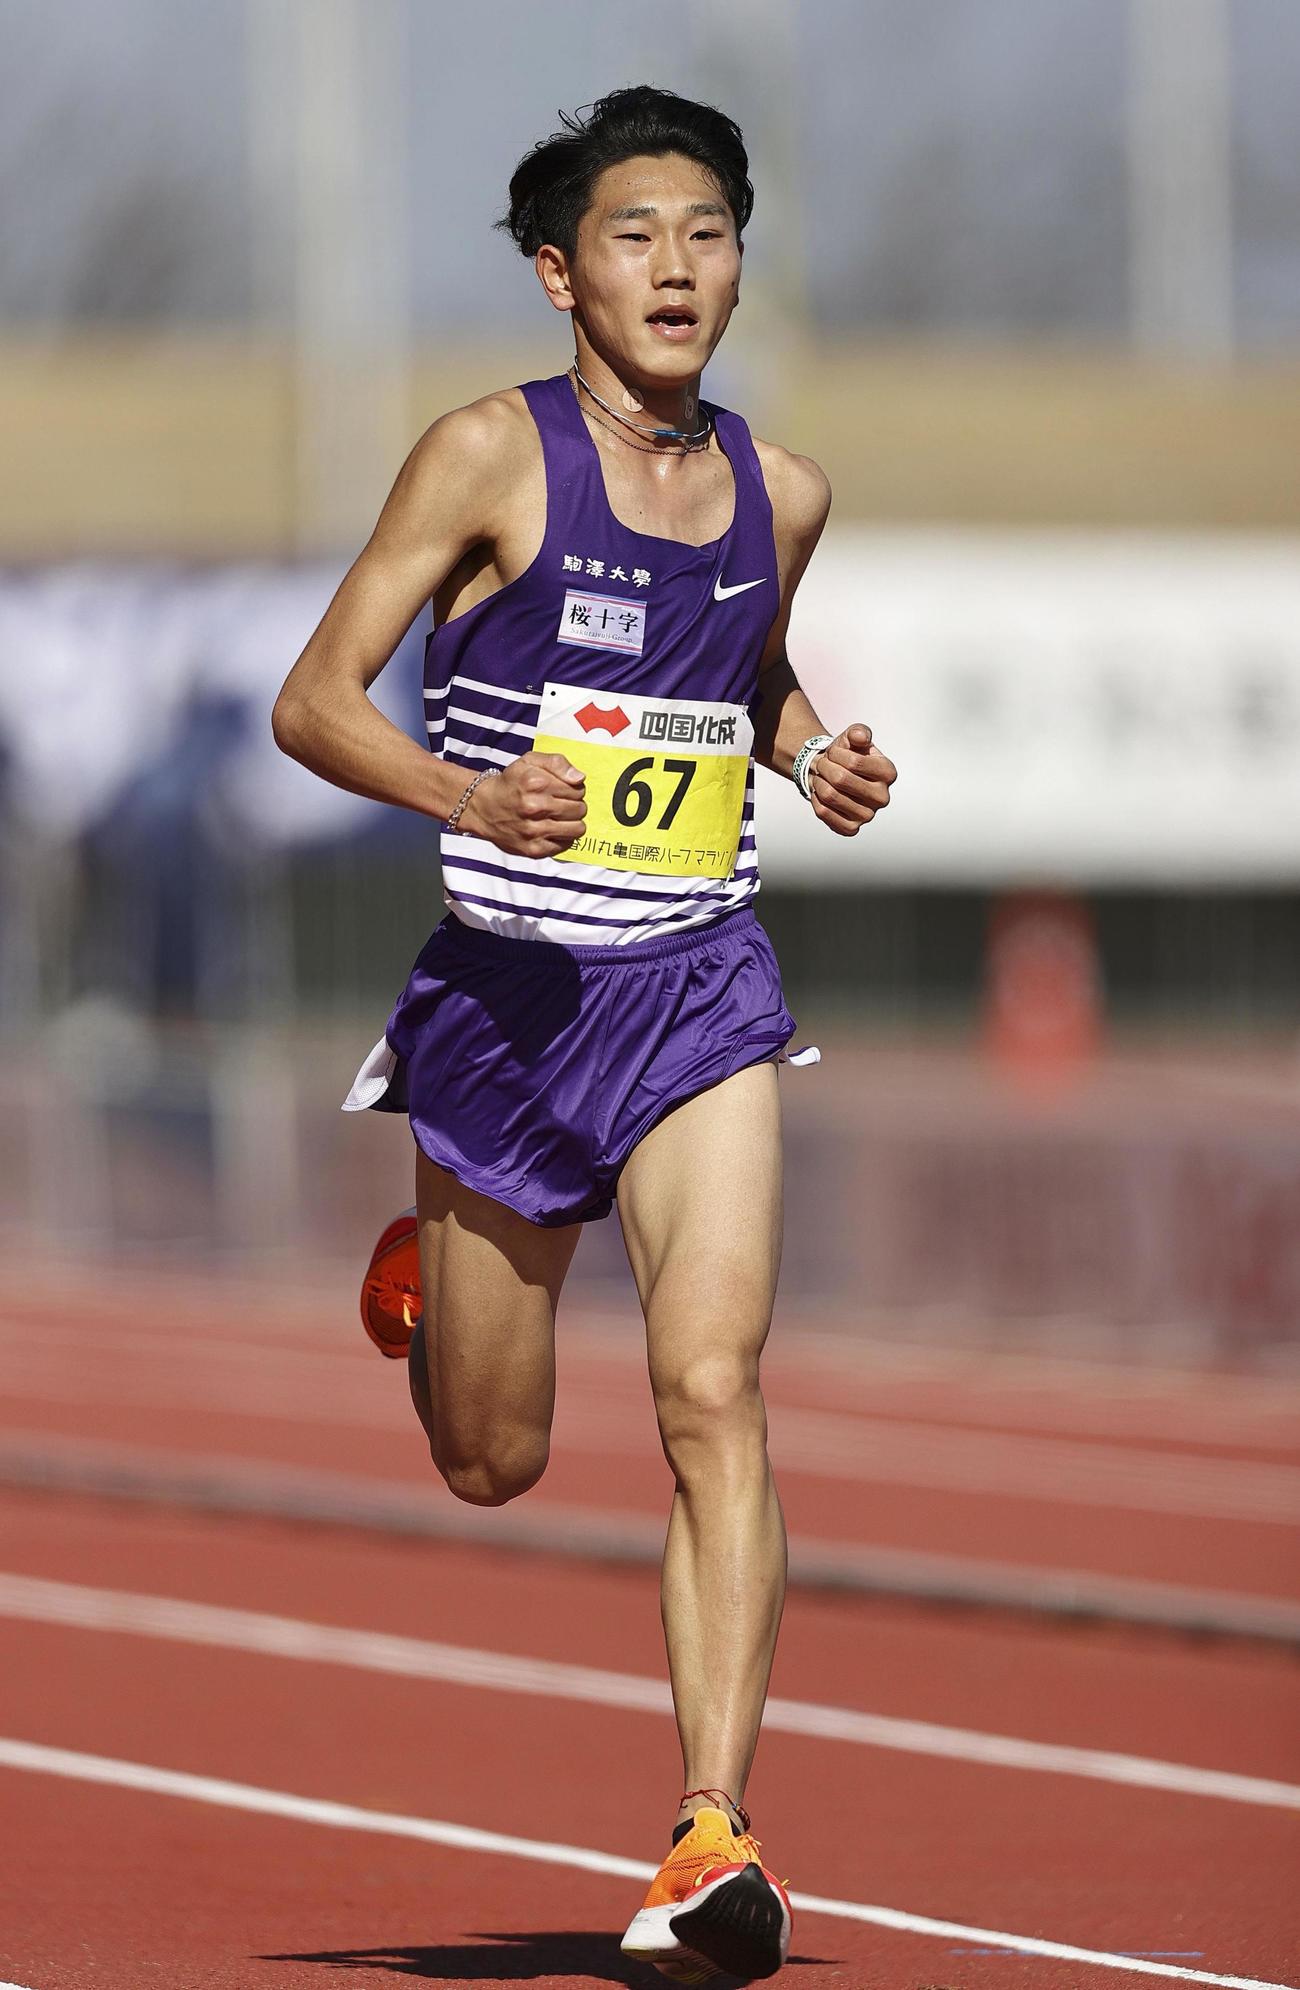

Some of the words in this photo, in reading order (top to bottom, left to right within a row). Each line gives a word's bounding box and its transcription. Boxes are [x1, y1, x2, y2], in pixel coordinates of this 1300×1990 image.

[562, 555, 652, 588] 駒澤大學
[569, 604, 639, 633] 桜十字
[638, 711, 737, 745] 四国化成
[612, 757, 697, 830] 67
